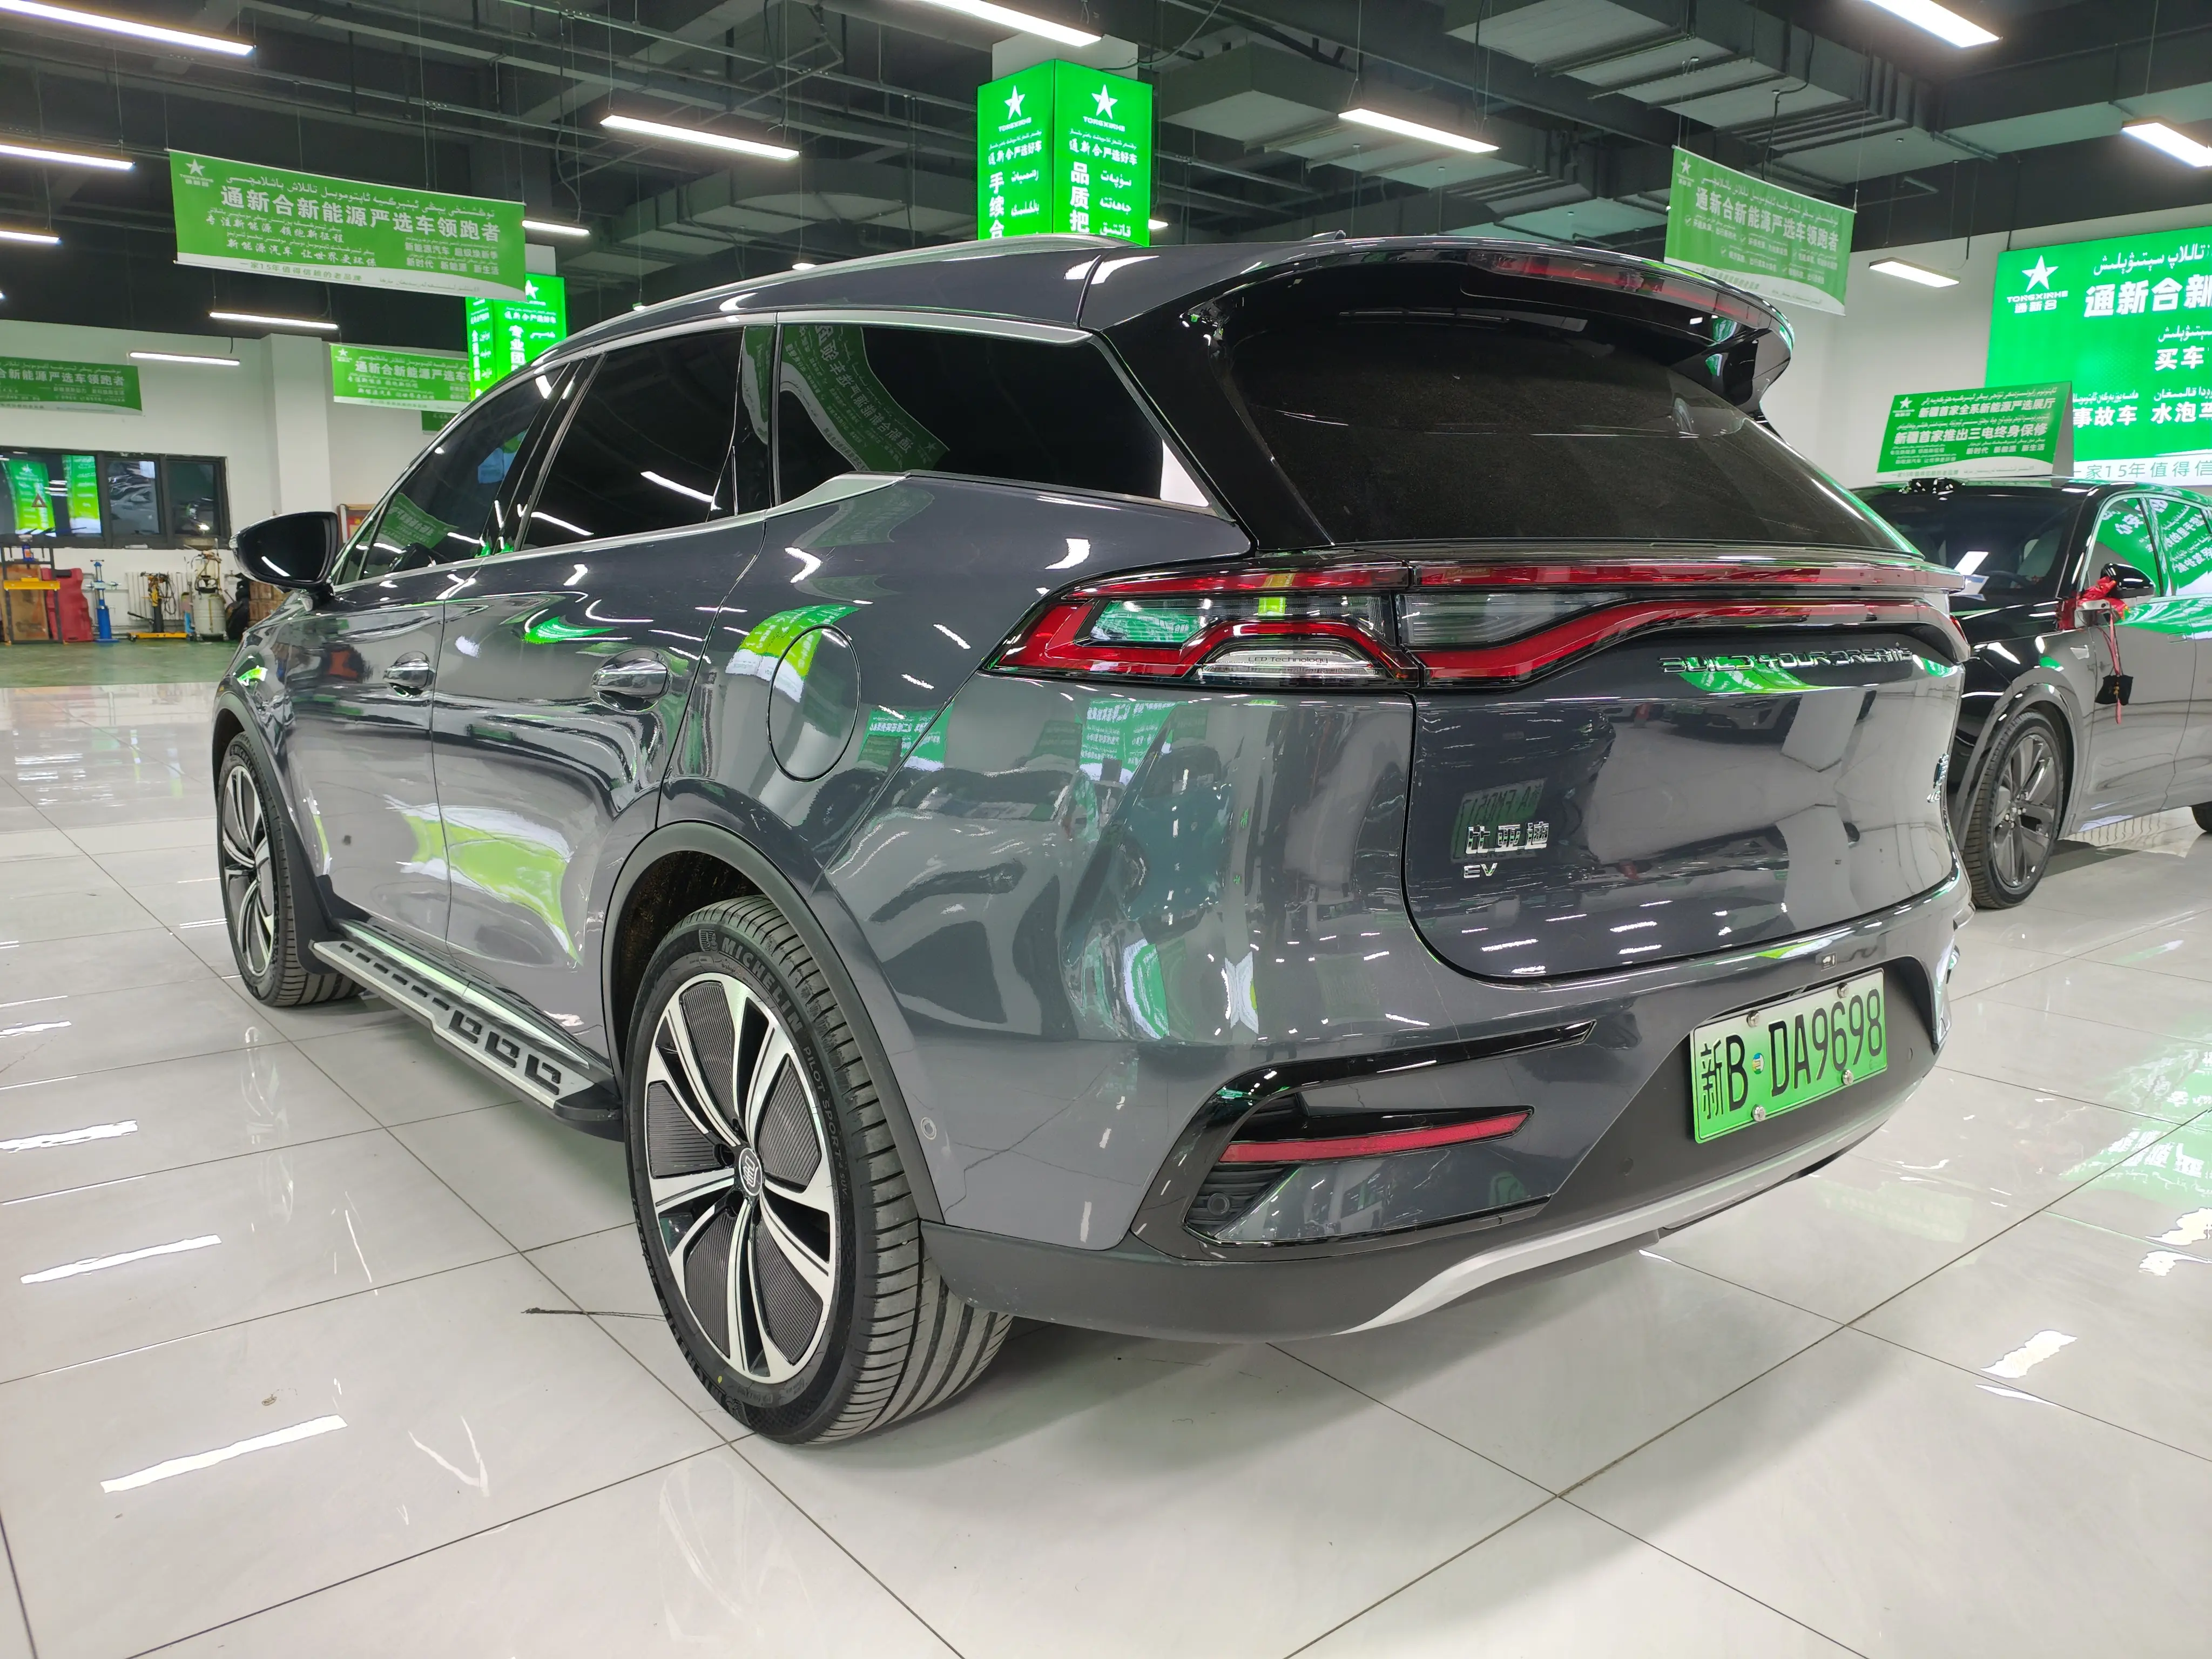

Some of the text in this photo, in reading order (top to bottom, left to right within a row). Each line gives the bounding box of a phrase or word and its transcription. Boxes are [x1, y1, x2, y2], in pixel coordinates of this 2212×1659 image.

[1069, 161, 1090, 233] 品质把
[220, 185, 500, 242] 通新合新能源严选车领跑者
[2006, 290, 2069, 304] TONGXINHE
[2014, 299, 2058, 314] 通新合
[354, 360, 470, 382] 通新合新能源严选车
[2073, 404, 2138, 428] 事故车
[1270, 657, 1328, 666] Technology
[1659, 655, 1755, 673] BUILD
[1759, 651, 1831, 669] YOUR
[1464, 862, 1498, 879] EV
[721, 937, 803, 1033] MICHELIN
[803, 1046, 826, 1092] PILOT
[822, 1098, 843, 1162] SPORT
